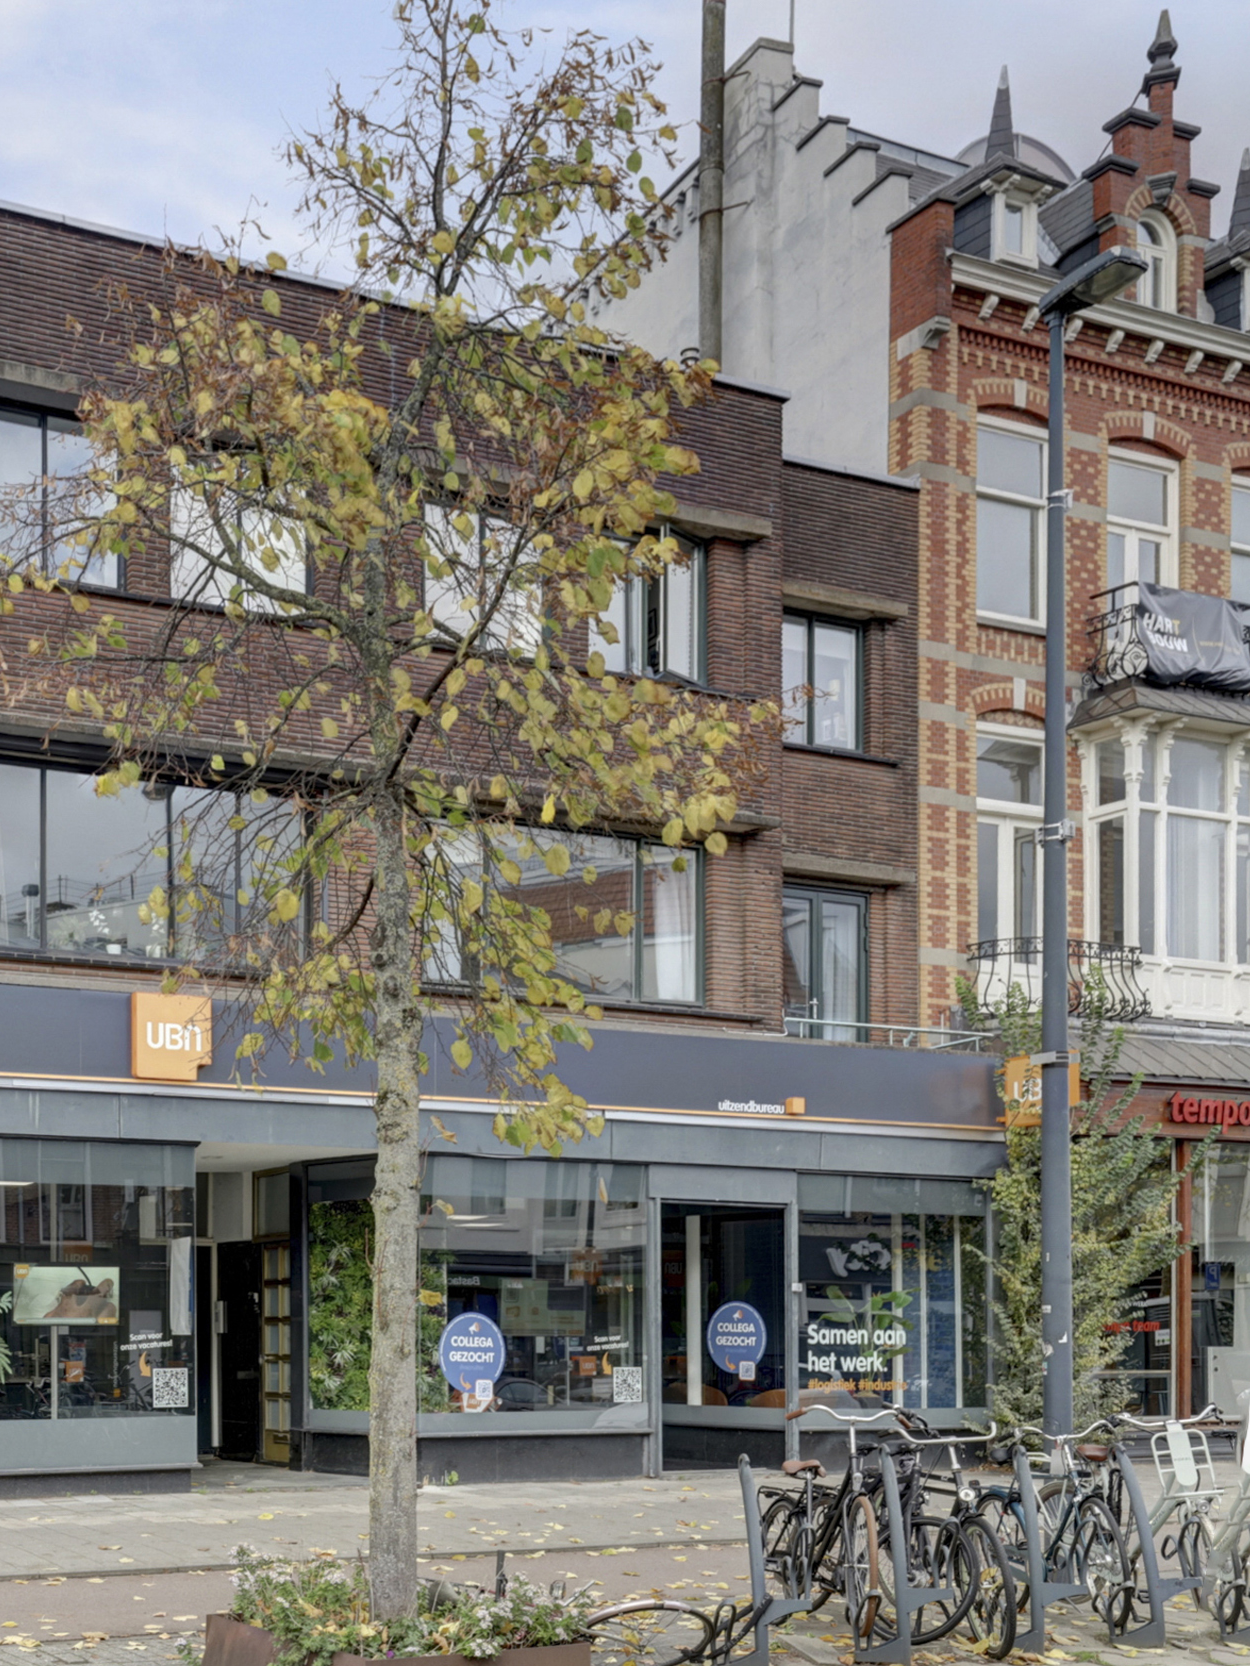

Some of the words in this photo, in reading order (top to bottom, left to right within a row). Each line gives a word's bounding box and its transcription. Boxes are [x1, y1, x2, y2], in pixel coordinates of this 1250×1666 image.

[1143, 612, 1180, 636] HART
[1013, 1078, 1042, 1103] UB
[718, 1099, 785, 1114] uitzendbureau
[1170, 1090, 1250, 1135] tempo
[717, 1322, 755, 1334] COLLEGA
[129, 1333, 147, 1342] Scan
[147, 1332, 163, 1340] voor
[451, 1335, 494, 1348] COLLEGA
[594, 1335, 608, 1344] Scan
[608, 1334, 622, 1342] voor
[716, 1336, 757, 1347] GEZOCHT
[807, 1324, 869, 1346] Samen
[873, 1328, 907, 1346] aan
[119, 1343, 138, 1351] onze
[138, 1339, 173, 1350] vacatures!
[586, 1344, 601, 1352] onze
[601, 1340, 630, 1350] vacatures!
[449, 1351, 495, 1363] GEZOCHT
[807, 1350, 837, 1372] het
[841, 1351, 888, 1372] werk.
[807, 1378, 857, 1395] #logistiek
[857, 1377, 908, 1391] #industrie
